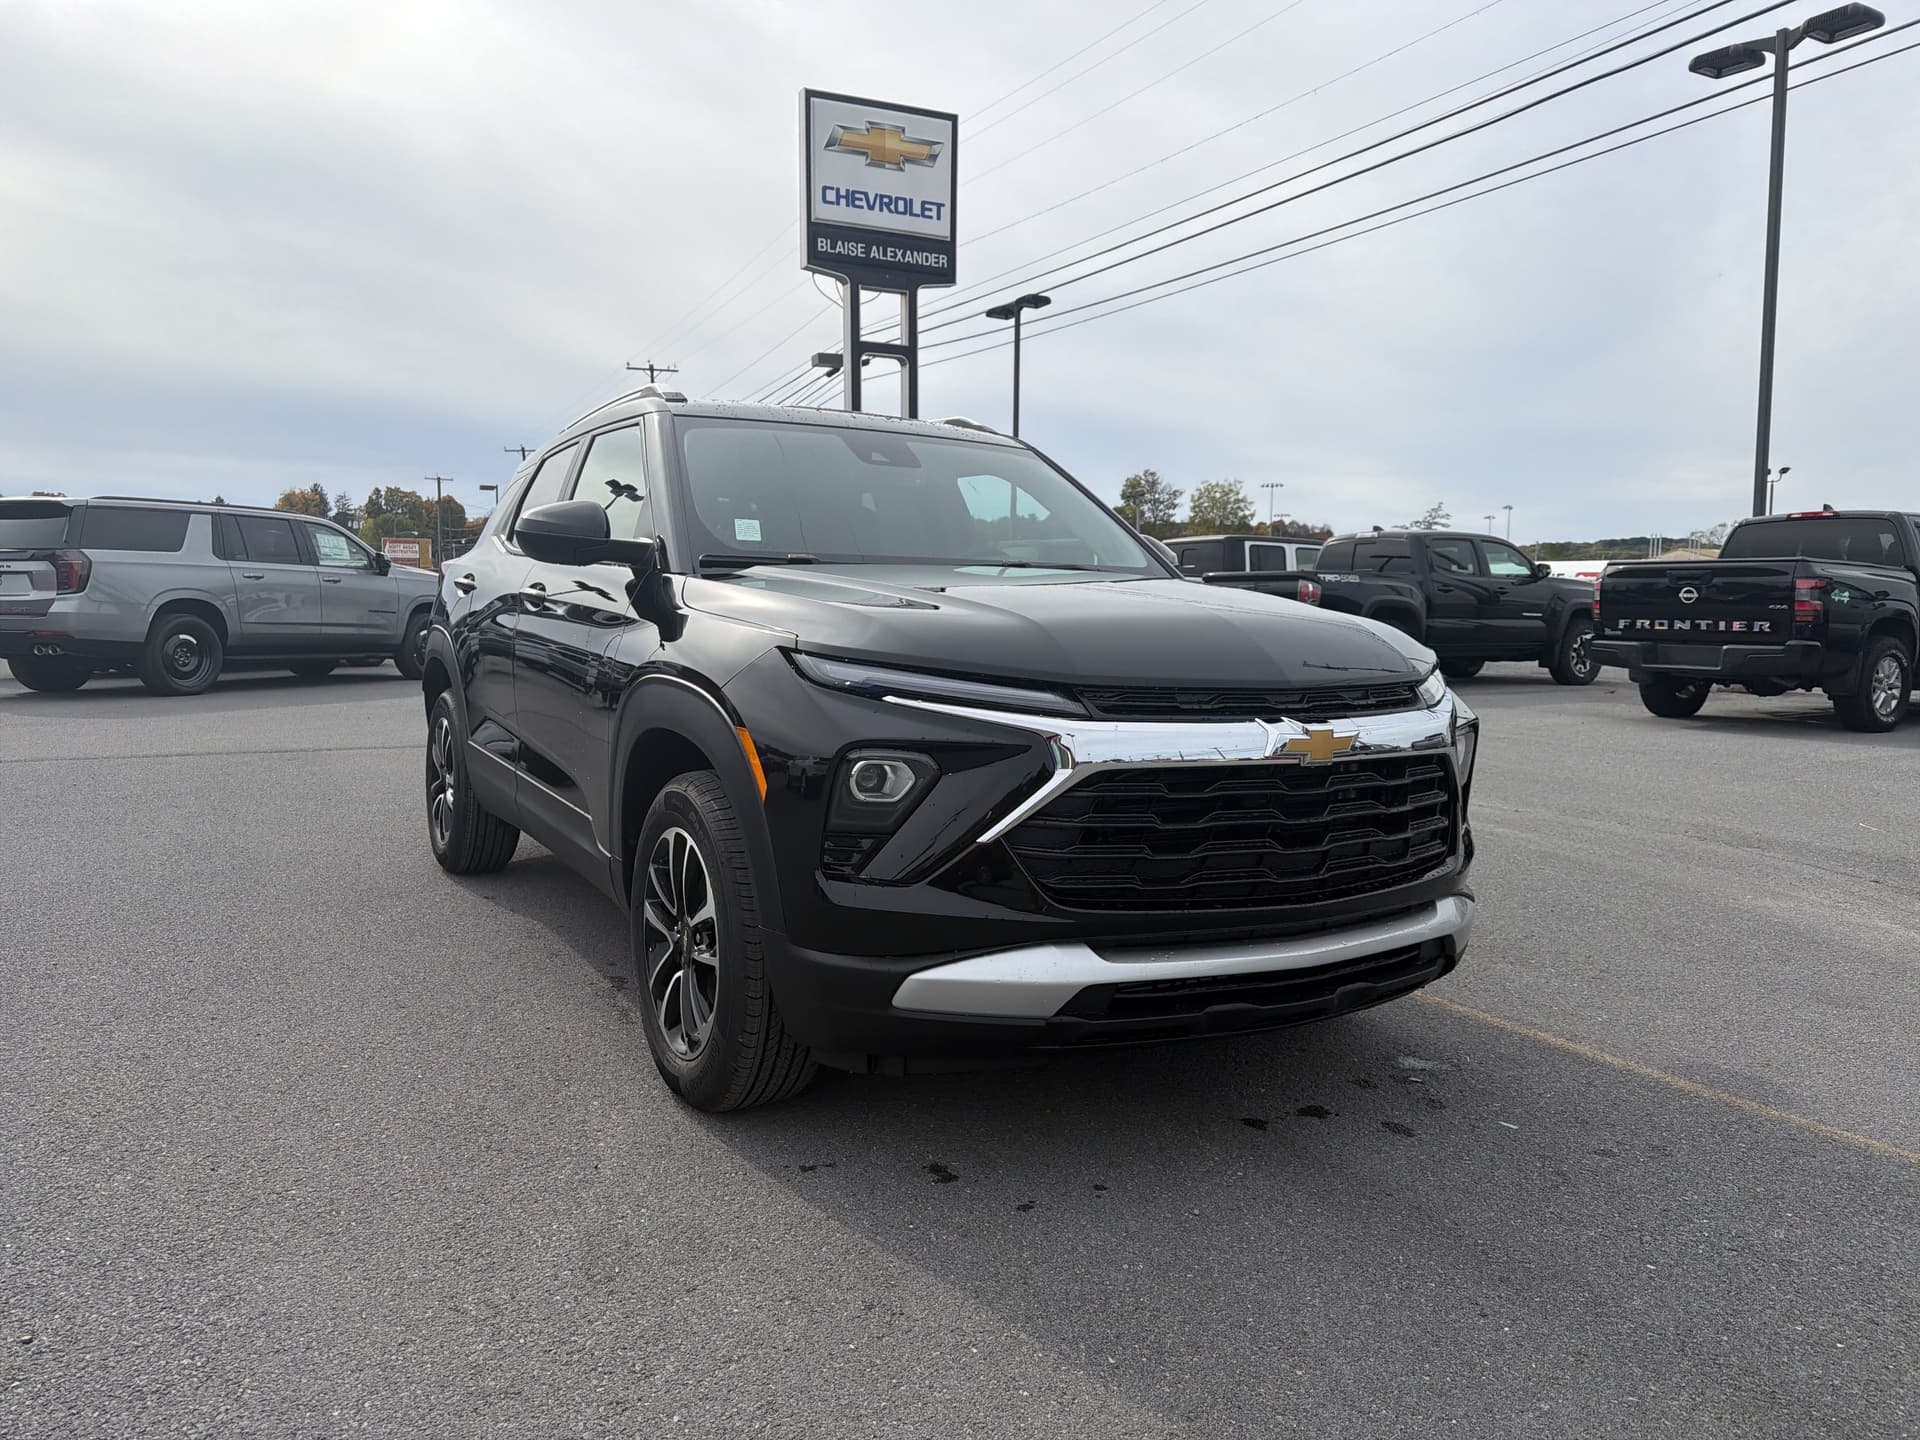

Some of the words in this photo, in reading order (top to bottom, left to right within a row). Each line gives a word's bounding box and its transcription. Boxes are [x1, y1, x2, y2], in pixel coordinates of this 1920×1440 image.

[821, 185, 945, 221] CHEVROLET
[817, 237, 866, 258] BLAISE
[870, 245, 948, 268] ALEXANDER
[1618, 619, 1772, 632] FRONTIER
